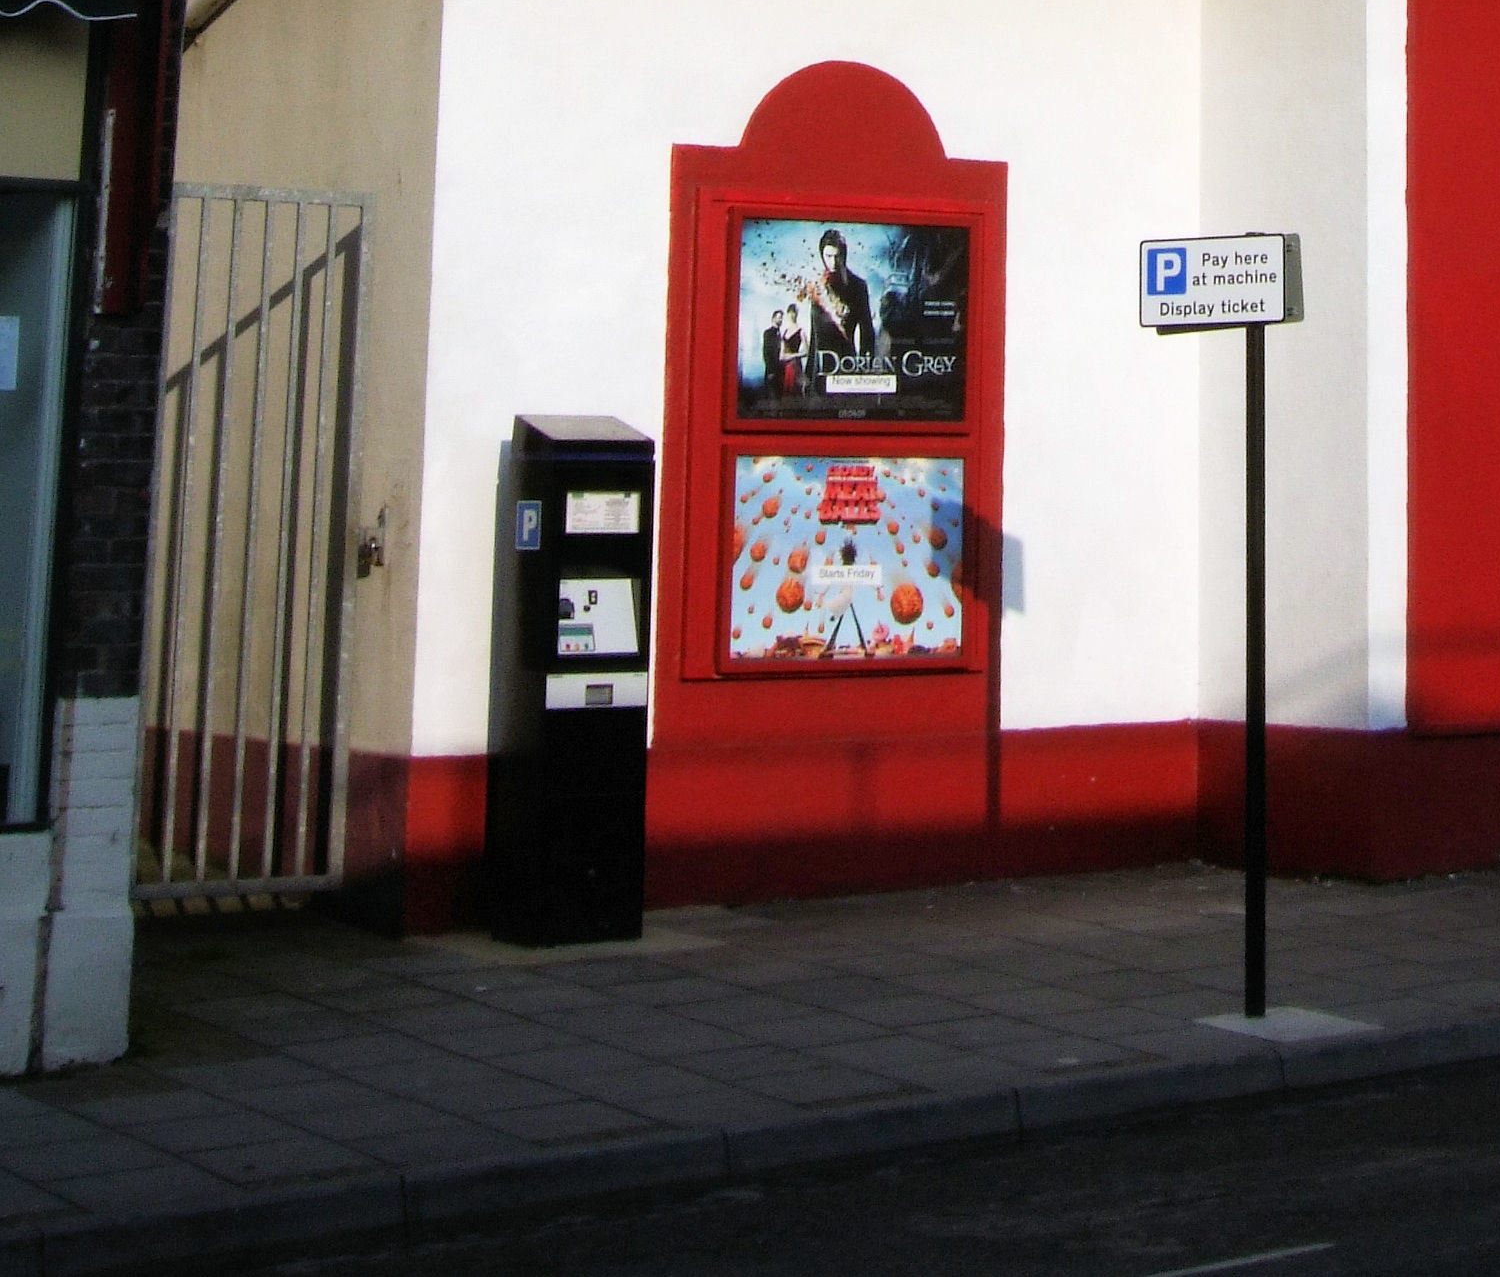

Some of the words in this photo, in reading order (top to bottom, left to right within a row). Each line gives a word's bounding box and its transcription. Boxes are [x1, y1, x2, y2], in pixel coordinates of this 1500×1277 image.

[1202, 252, 1228, 268] Pay
[1234, 251, 1268, 264] here
[1156, 253, 1181, 291] P
[1192, 273, 1207, 286] at
[1213, 270, 1277, 285] machine
[1160, 301, 1215, 317] Display
[1221, 299, 1266, 313] ticket
[523, 509, 538, 542] P
[819, 568, 845, 579] Starts
[847, 568, 875, 580] Friday
